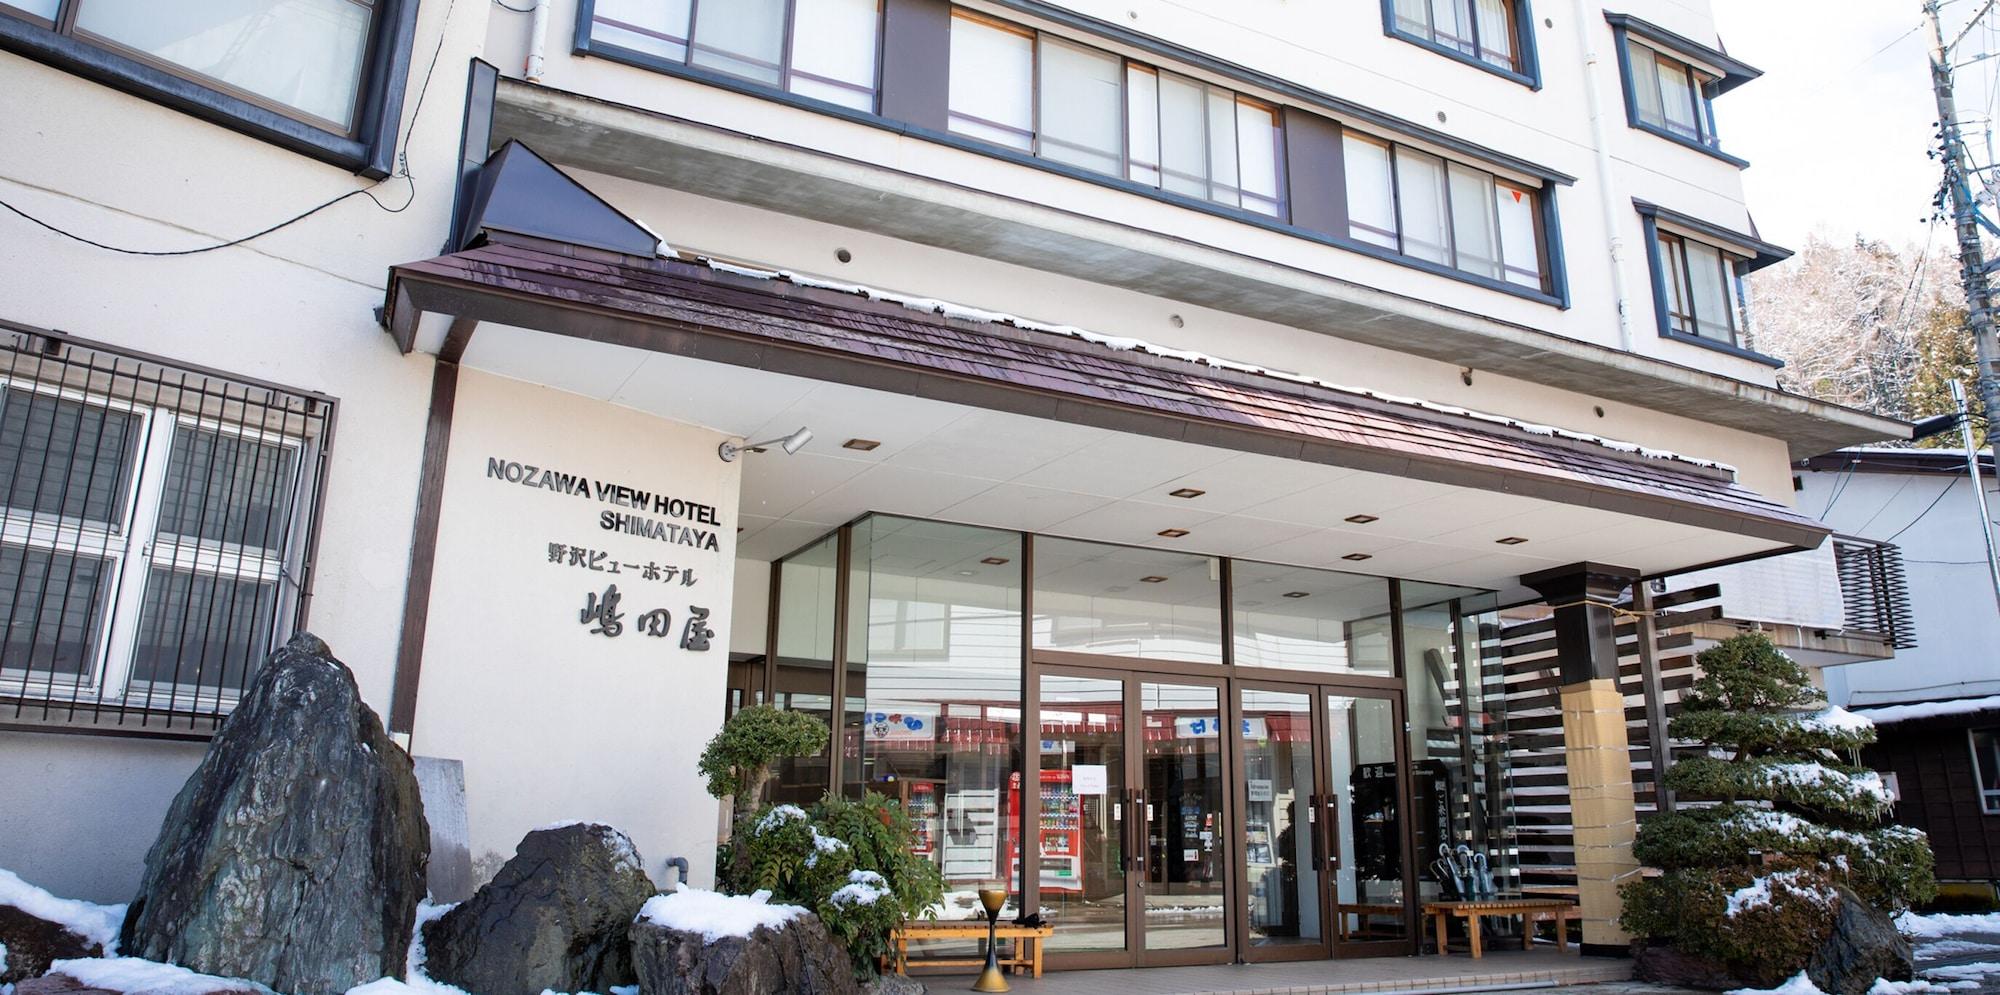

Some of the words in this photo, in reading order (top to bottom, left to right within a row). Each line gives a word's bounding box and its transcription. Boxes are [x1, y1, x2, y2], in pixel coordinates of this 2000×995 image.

[487, 457, 591, 499] NOZAWA
[595, 480, 651, 511] VIEW
[654, 494, 721, 526] HOTEL
[599, 510, 720, 552] SHIMATAYA
[548, 541, 698, 587] 野沢ビューホテル
[580, 583, 715, 652] 嶋田屋
